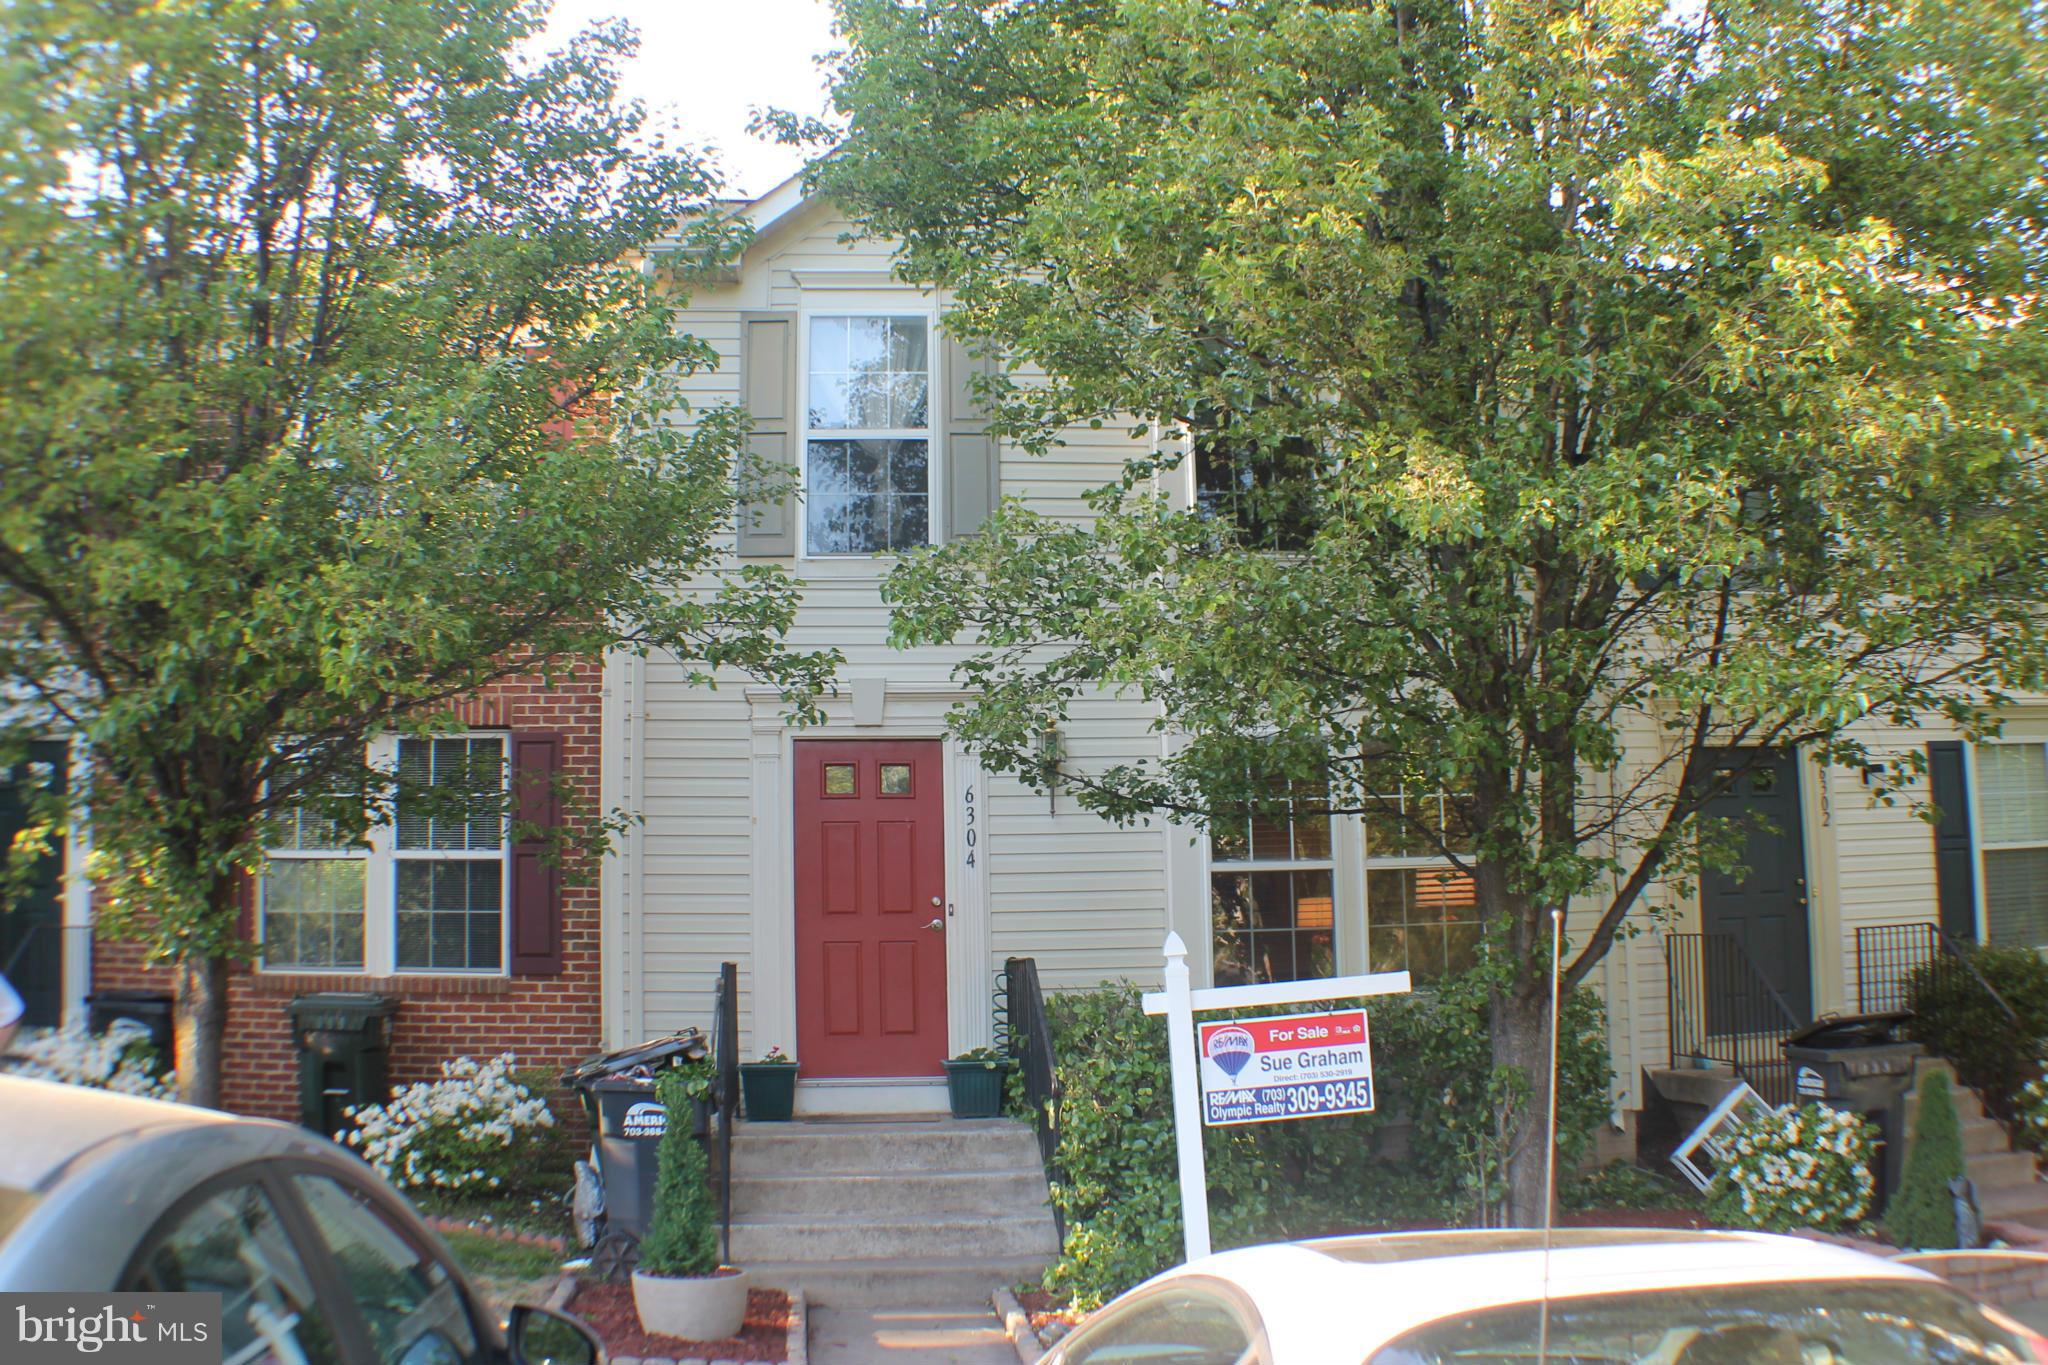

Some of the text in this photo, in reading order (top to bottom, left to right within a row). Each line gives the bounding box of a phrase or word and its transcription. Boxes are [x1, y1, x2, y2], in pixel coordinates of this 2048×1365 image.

[965, 784, 976, 868] 6304
[1213, 1035, 1250, 1049] RE/MAX
[1269, 1028, 1294, 1042] For
[1297, 1025, 1329, 1040] Sale
[1260, 1049, 1363, 1072] Sue Graham
[1273, 1073, 1299, 1082] Direct:
[1300, 1072, 1319, 1081] (703)
[1210, 1089, 1256, 1106] RE/MAX
[1261, 1081, 1368, 1113] (703) 309-9345
[1211, 1100, 1286, 1120] Olympic Realty
